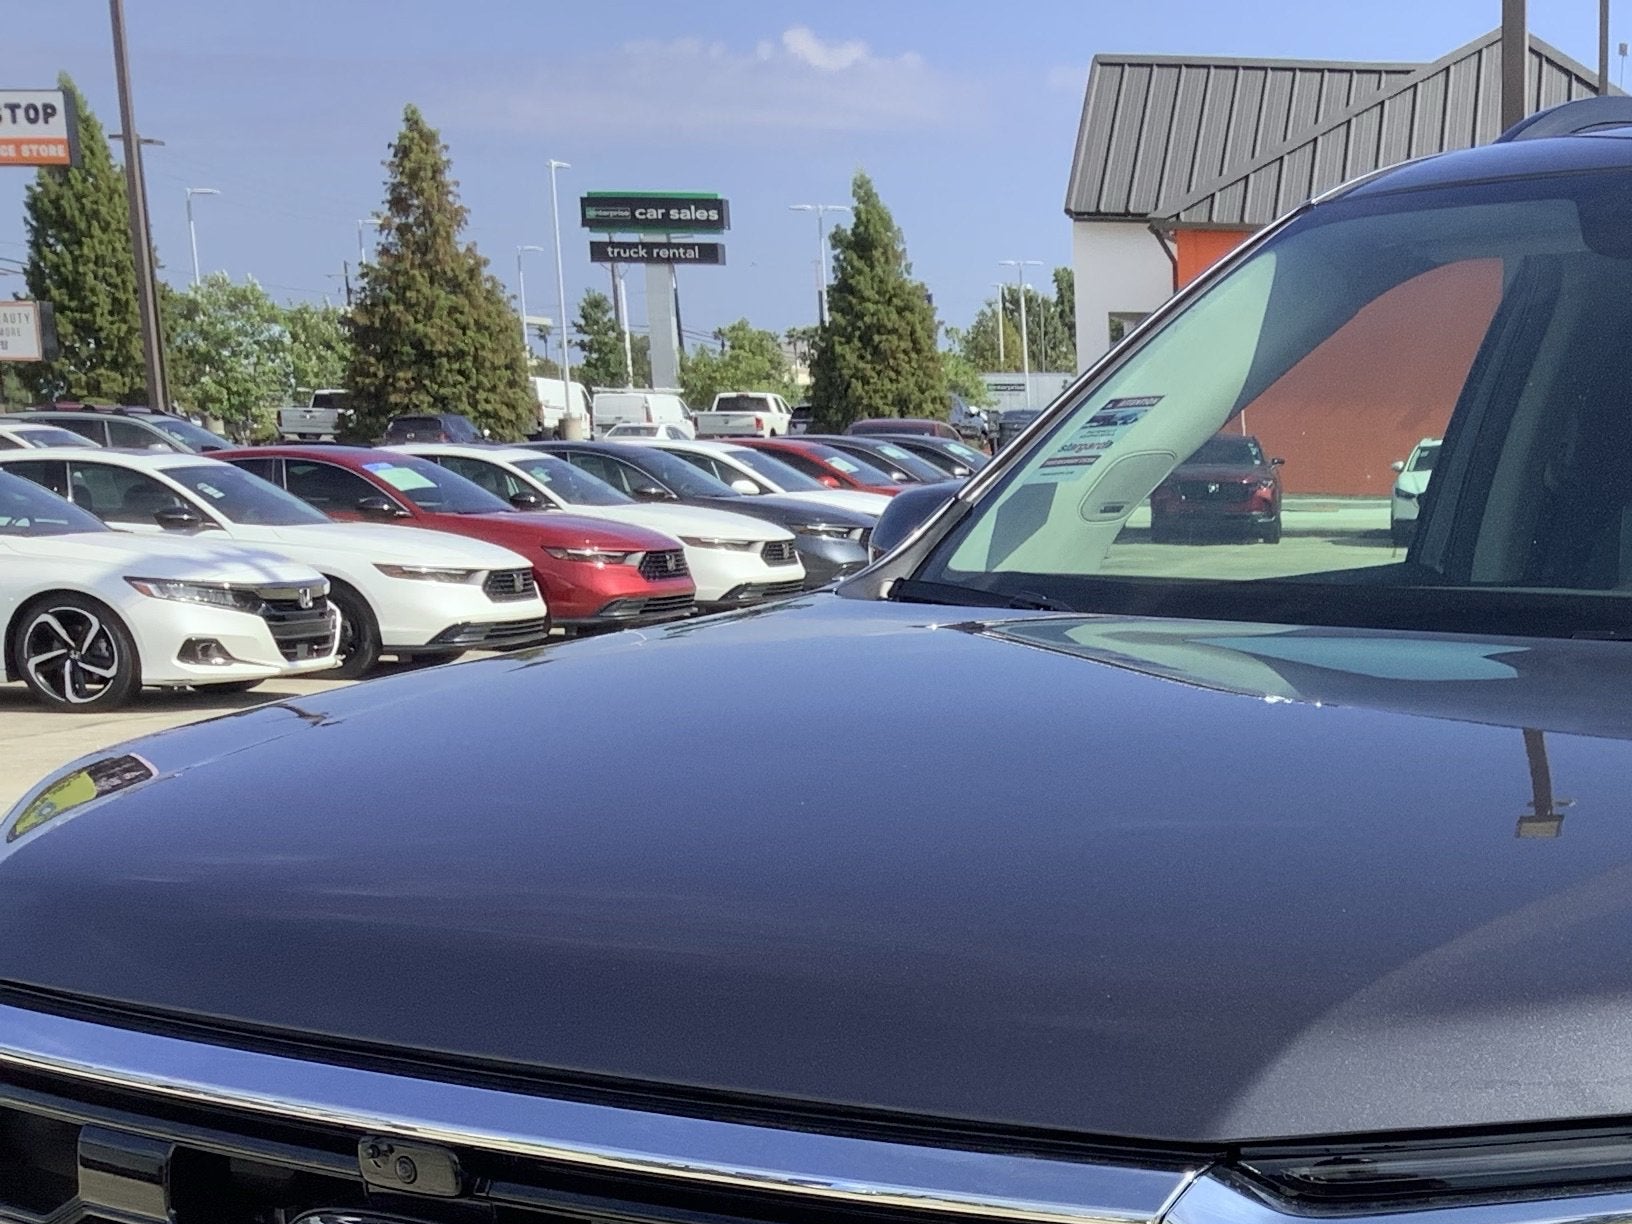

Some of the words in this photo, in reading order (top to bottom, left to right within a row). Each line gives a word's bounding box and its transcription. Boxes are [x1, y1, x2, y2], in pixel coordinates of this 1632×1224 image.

[0, 102, 57, 125] TOP
[21, 143, 66, 158] STORE
[635, 207, 666, 220] car
[669, 205, 719, 220] sales
[607, 245, 648, 258] truck
[653, 246, 700, 259] rental
[0, 312, 31, 324] AUTY
